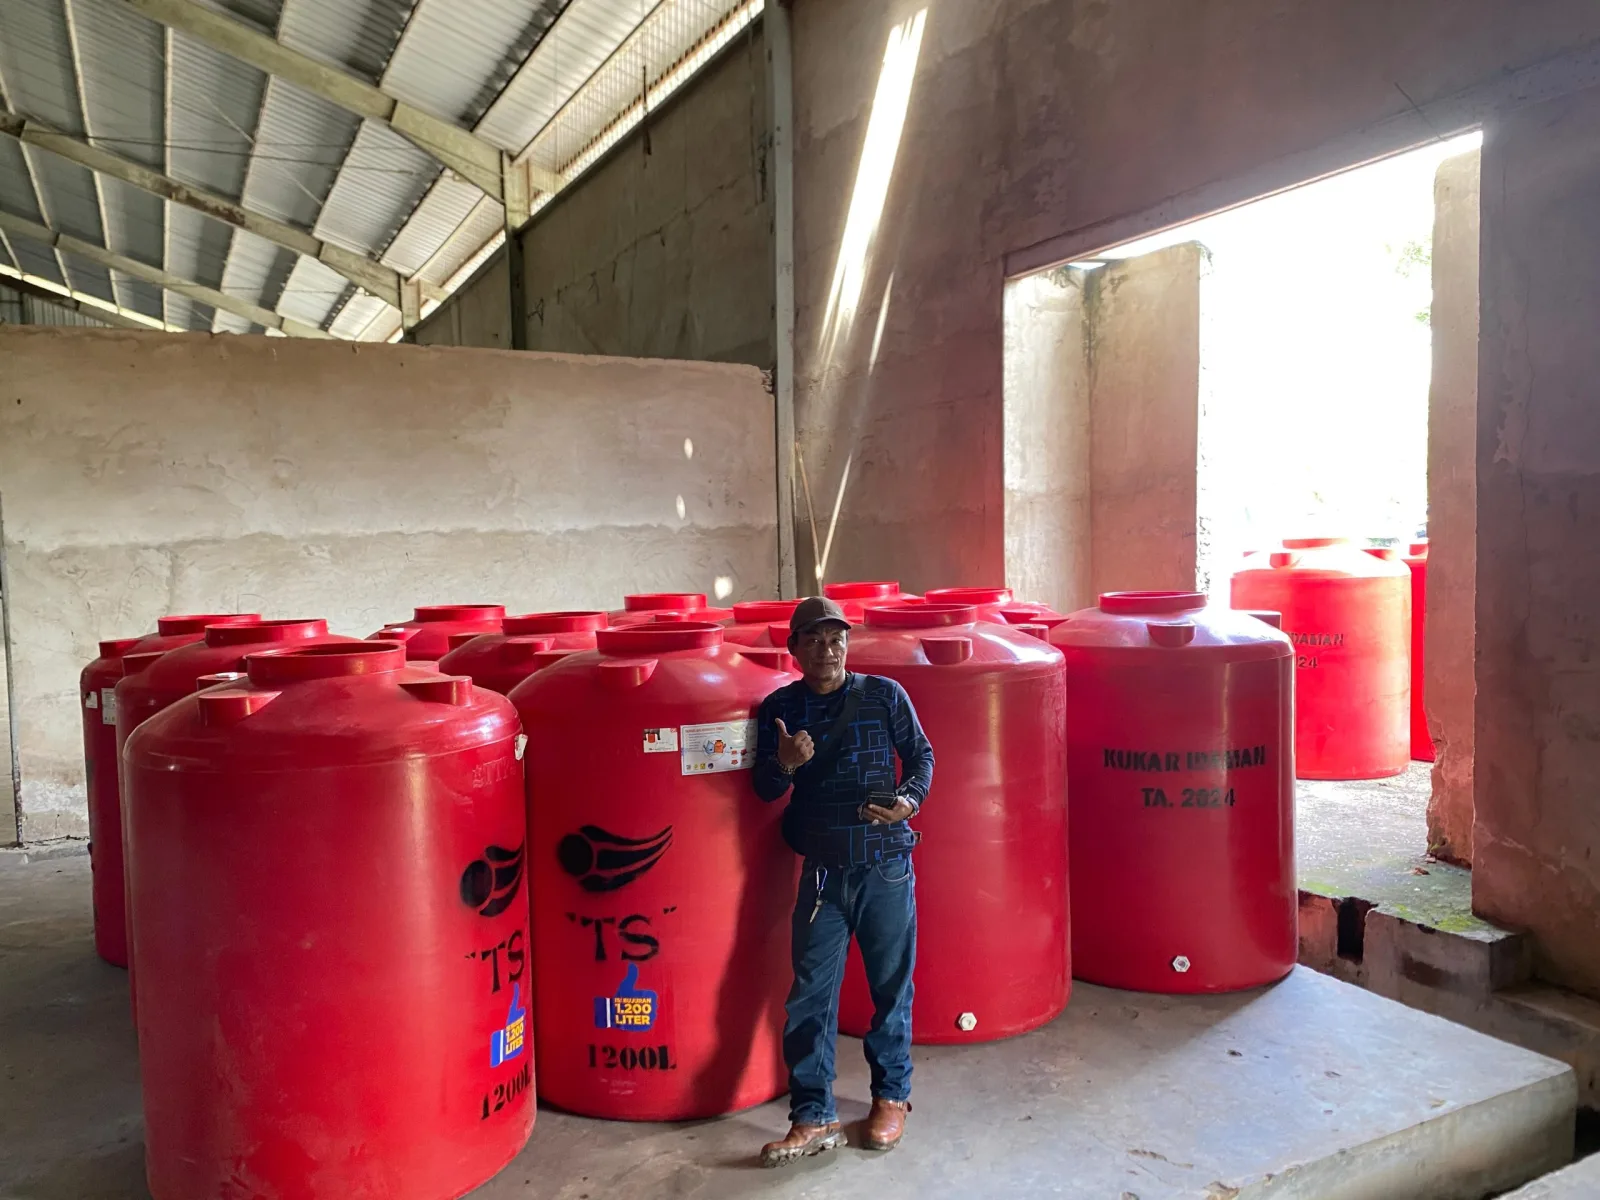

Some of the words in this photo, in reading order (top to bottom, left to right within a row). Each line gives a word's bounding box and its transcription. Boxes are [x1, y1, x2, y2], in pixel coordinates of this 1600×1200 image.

[1296, 655, 1318, 669] 24
[1103, 748, 1180, 772] KUKAR
[1141, 787, 1174, 808] TA.
[1180, 787, 1236, 808] 2024
[614, 1003, 652, 1014] 1.200
[615, 1015, 651, 1025] LITER
[588, 1043, 677, 1071] 1200L
